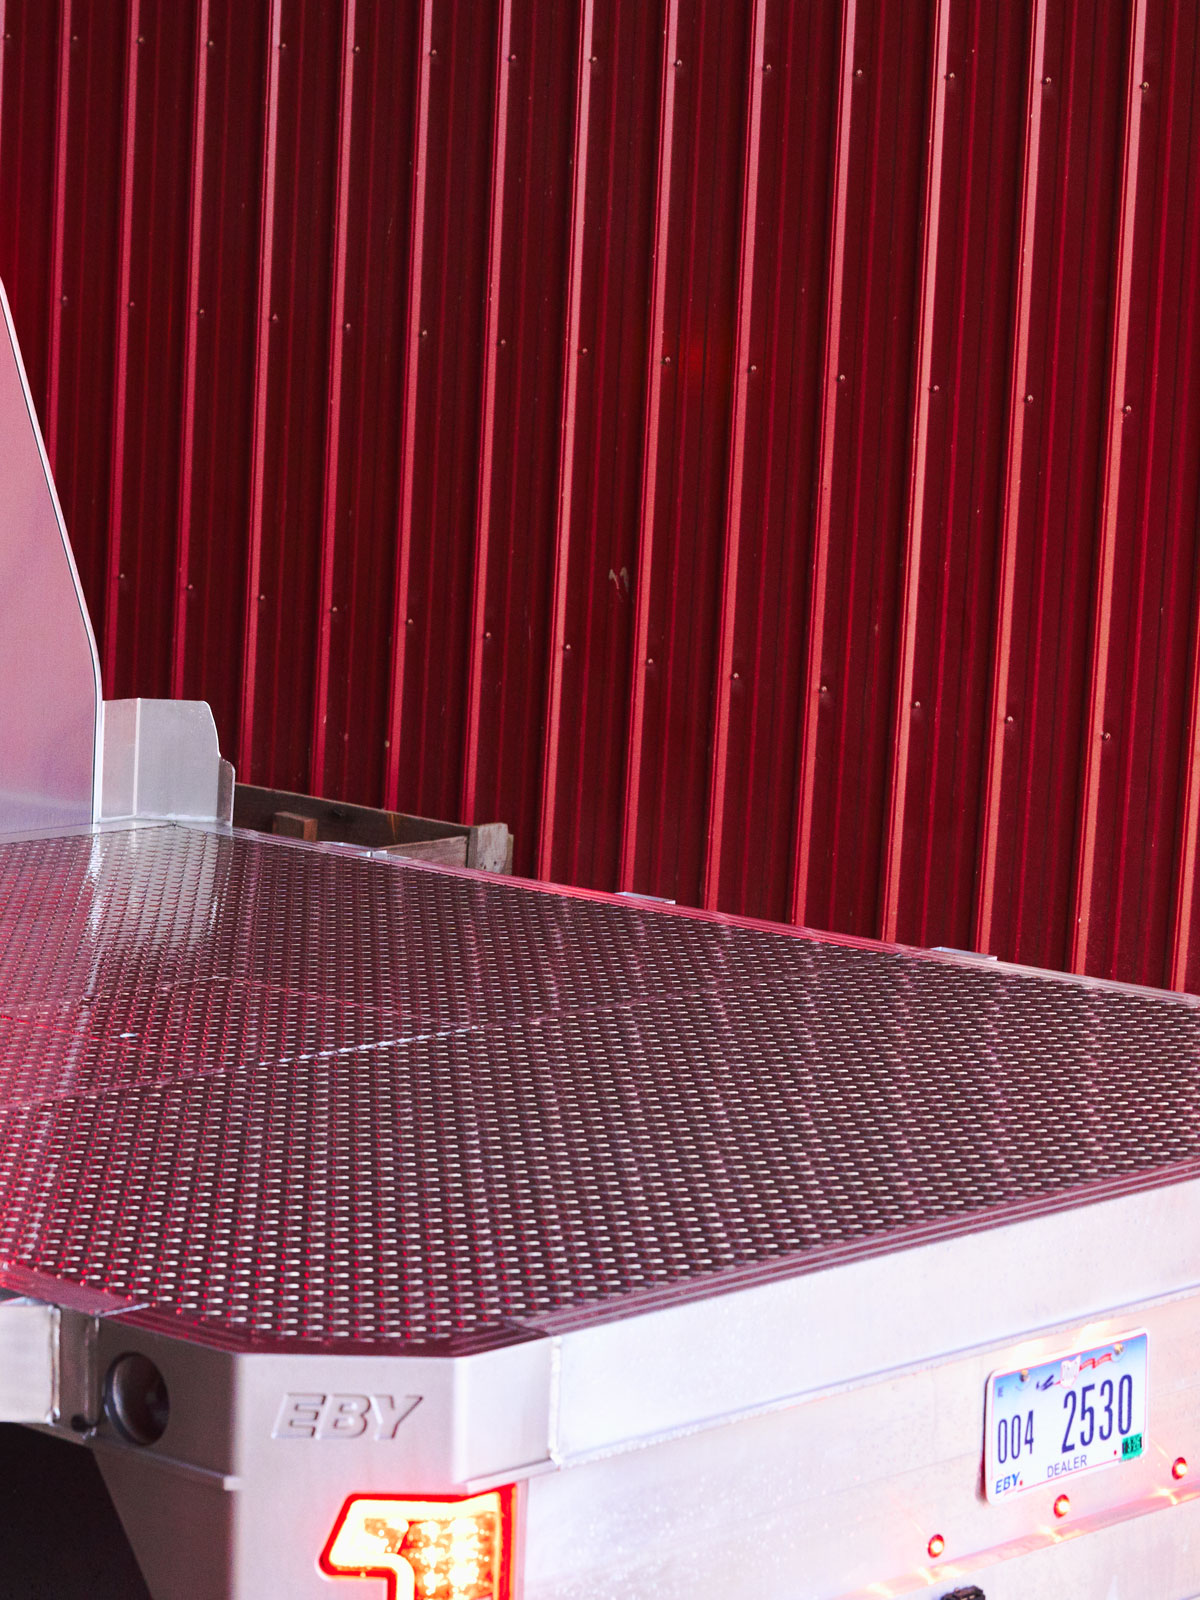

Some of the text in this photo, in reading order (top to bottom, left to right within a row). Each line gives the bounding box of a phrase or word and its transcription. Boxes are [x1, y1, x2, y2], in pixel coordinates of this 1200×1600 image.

[271, 1392, 424, 1440] EBY
[997, 1374, 1133, 1464] 004 2530
[995, 1471, 1021, 1495] EBY
[1047, 1454, 1088, 1479] DEALER
